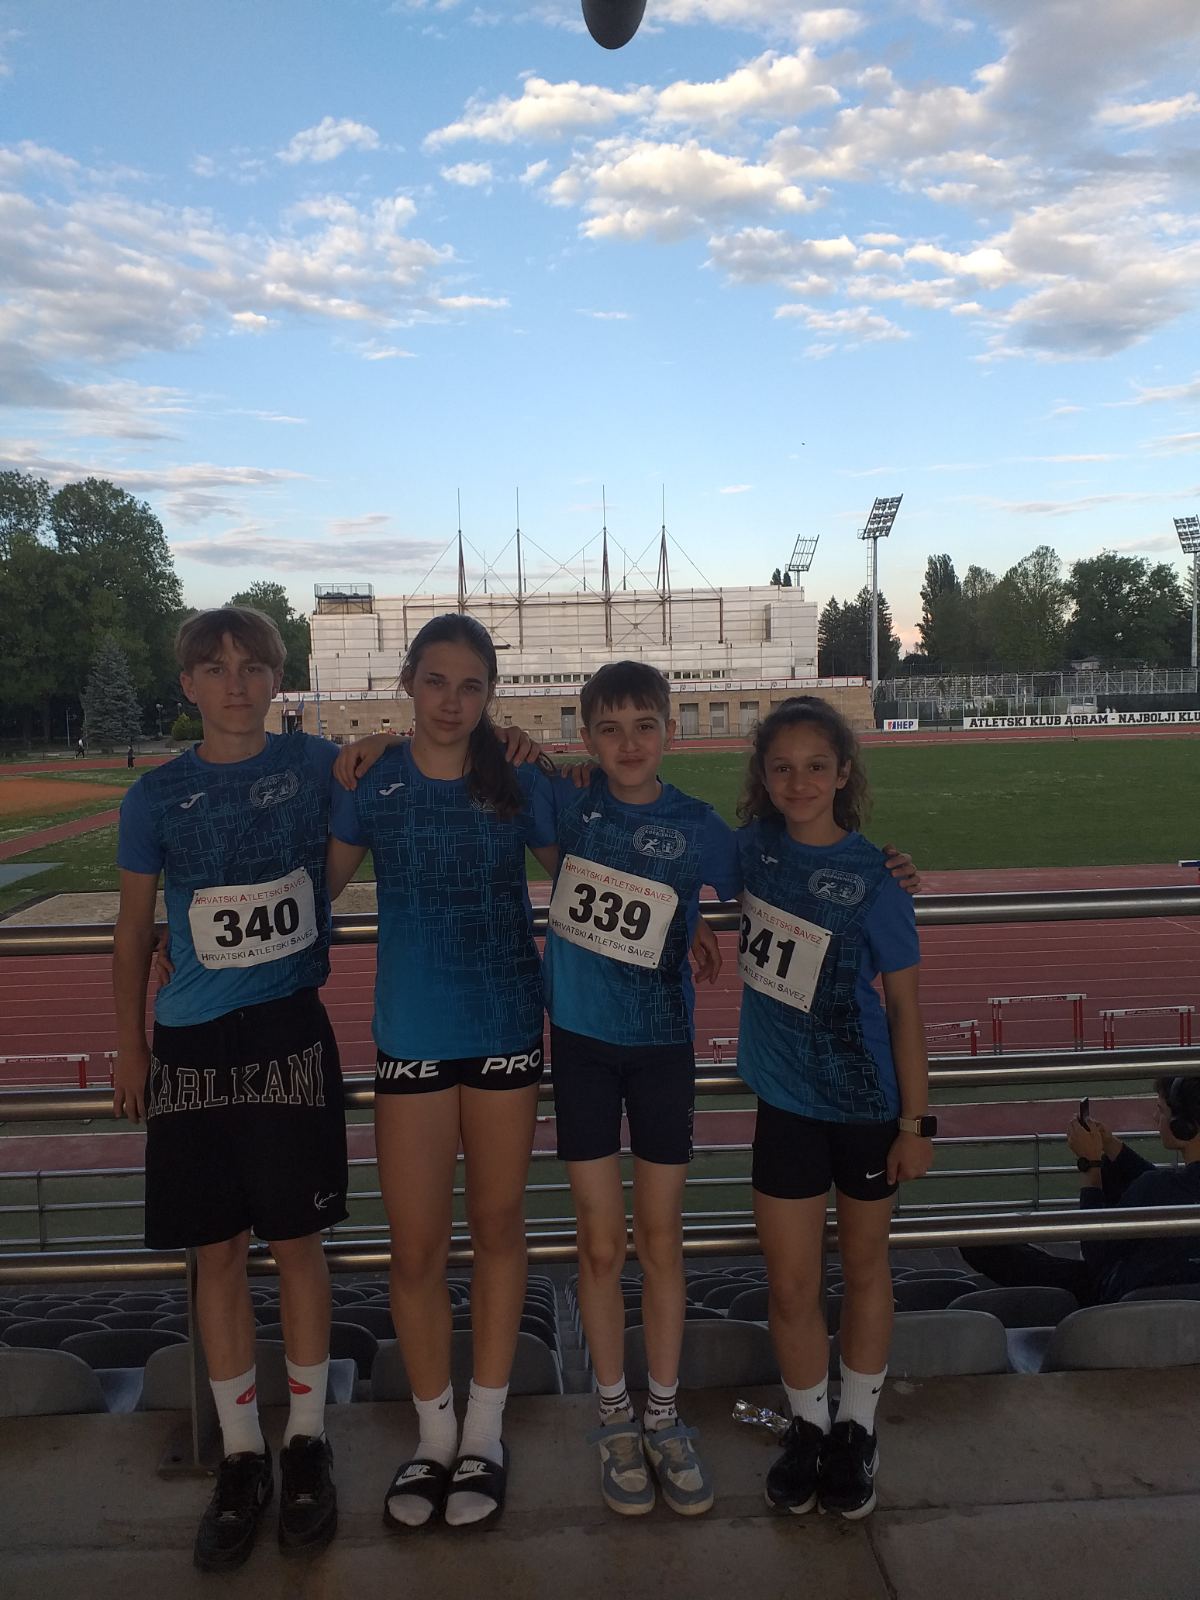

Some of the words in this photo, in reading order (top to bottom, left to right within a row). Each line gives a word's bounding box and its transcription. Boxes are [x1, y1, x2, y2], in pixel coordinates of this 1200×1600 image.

[897, 720, 914, 730] HEP
[969, 717, 1026, 728] ATLETSKI
[1030, 716, 1061, 726] KLUB
[1064, 714, 1108, 725] AGRAM
[1118, 712, 1175, 723] NAJBOLJI
[194, 896, 238, 905] HRVATSKI
[239, 888, 283, 902] ATLETSKI
[284, 875, 307, 892] SAVEZ
[565, 861, 603, 881] HRVATSKI
[603, 876, 644, 894] ATLETSKI
[644, 887, 673, 903] SAVEZ
[213, 897, 299, 948] 340
[568, 883, 651, 941] 339
[757, 909, 793, 932] ATLETSKI
[793, 926, 823, 945] SAVEZ
[201, 953, 247, 961] HRVATSKI
[247, 942, 289, 957] ATLETSKI
[290, 929, 313, 945] SAVEZ
[551, 918, 587, 938] HRVATSKI
[587, 932, 627, 951] ATLETSKI
[627, 945, 656, 960] SAVEZ
[739, 914, 796, 979] 341
[743, 965, 777, 989] ATLETSKI
[777, 983, 806, 1002] SAVEZ
[231, 1041, 326, 1107] KANI
[481, 1049, 541, 1075] PRO
[403, 1464, 431, 1477] NIKE
[460, 1459, 487, 1473] NIKE
